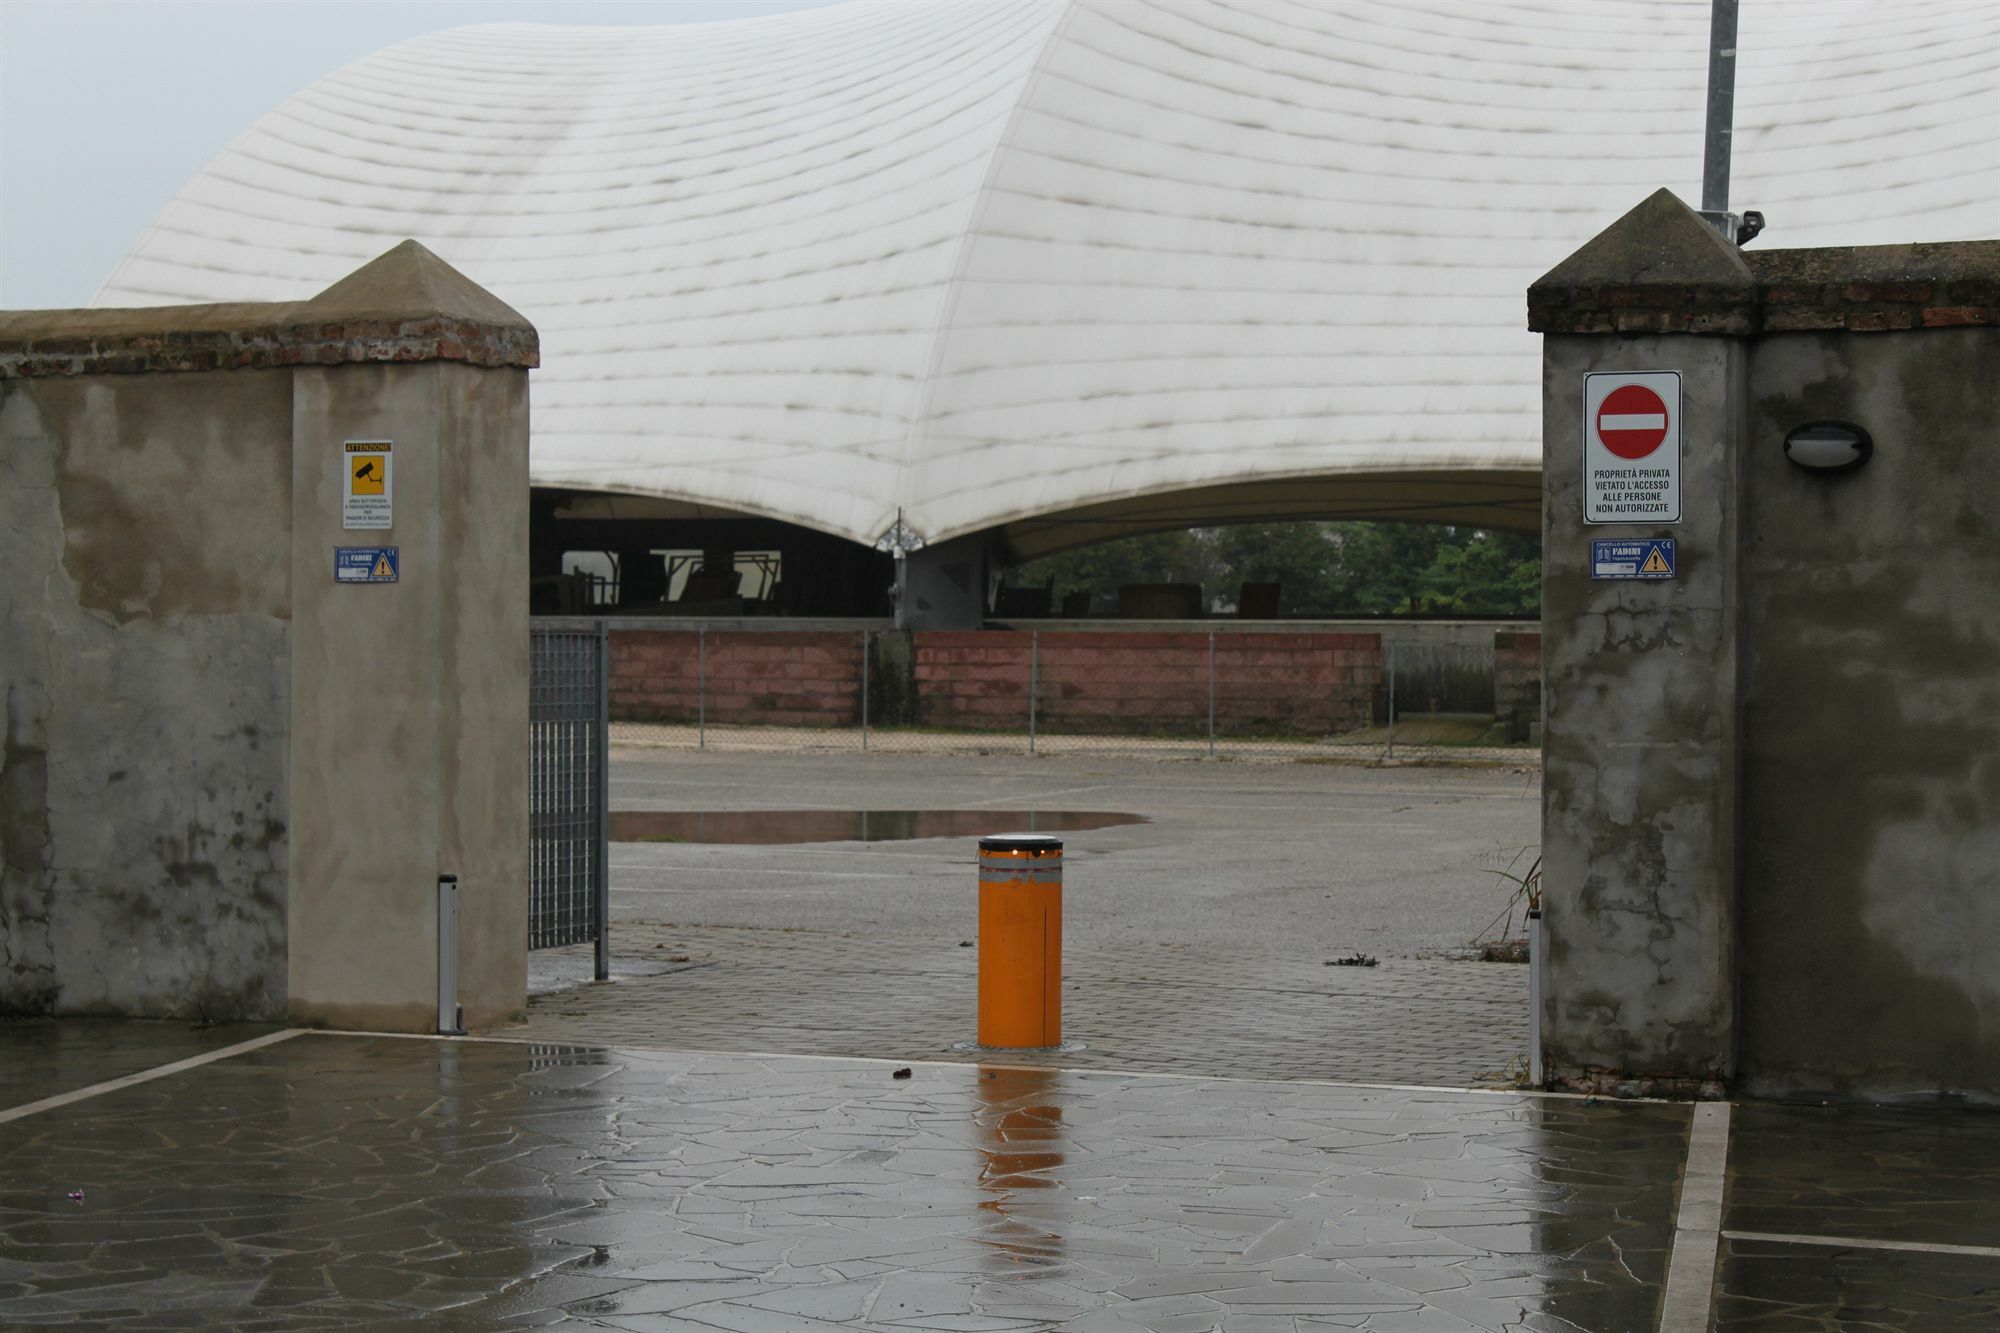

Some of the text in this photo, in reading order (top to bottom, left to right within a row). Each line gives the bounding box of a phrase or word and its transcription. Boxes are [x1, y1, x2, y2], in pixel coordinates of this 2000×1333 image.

[1594, 467, 1670, 479] PROPRIETÀ PRIVATA
[1595, 480, 1669, 490] VIETATO L'ACCESSO
[1602, 492, 1662, 501] ALLE PERSONE
[1596, 503, 1669, 513] NON AUTORIZZATE
[1613, 548, 1641, 556] FADINI
